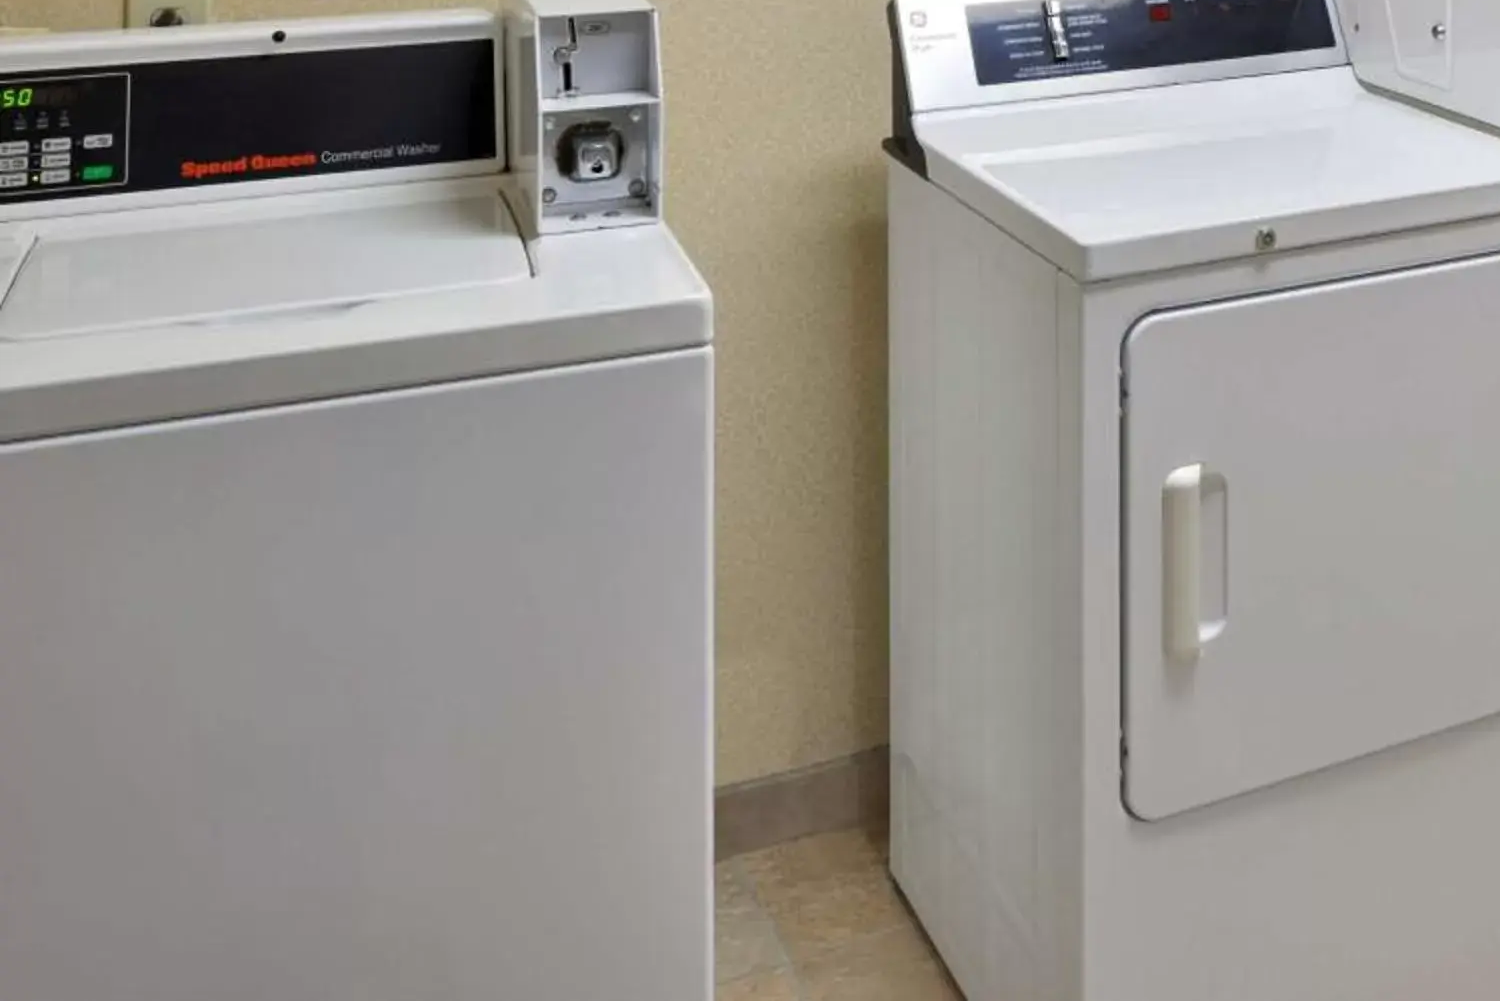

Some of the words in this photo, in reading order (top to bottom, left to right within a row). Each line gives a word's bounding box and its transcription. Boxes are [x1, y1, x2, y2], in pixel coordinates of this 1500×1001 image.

[181, 156, 247, 178] Speed
[250, 152, 316, 170] Queen
[320, 145, 394, 164] Commercial
[397, 142, 441, 157] Washer
